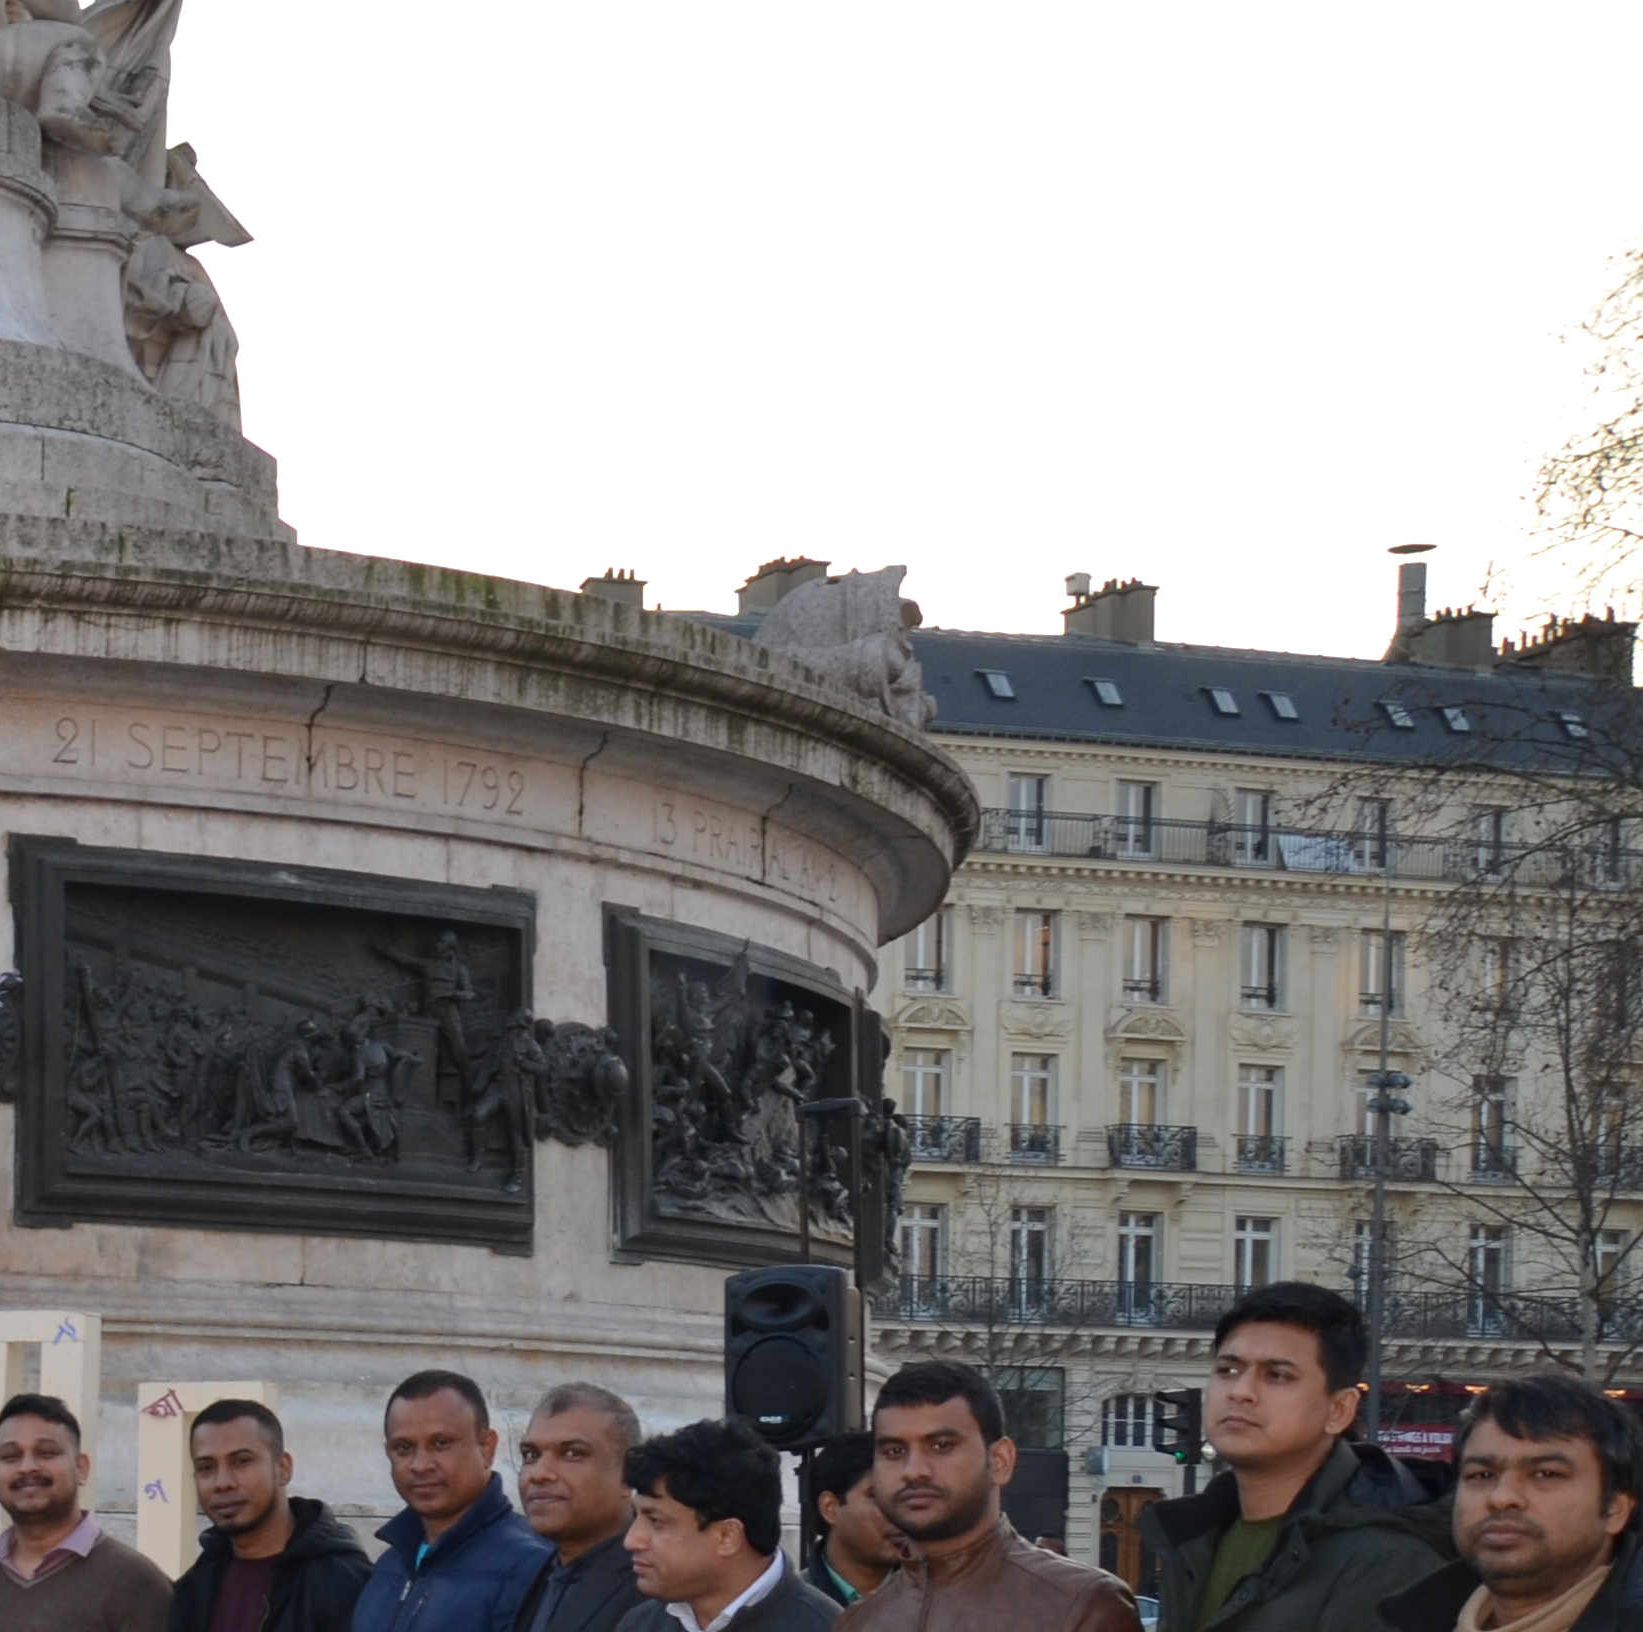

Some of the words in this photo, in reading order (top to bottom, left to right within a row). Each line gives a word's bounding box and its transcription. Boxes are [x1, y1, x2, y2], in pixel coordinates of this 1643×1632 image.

[51, 716, 98, 767] 21
[127, 721, 418, 800] SEPTEMBRE
[441, 757, 527, 816] 1792
[652, 799, 678, 846] 13
